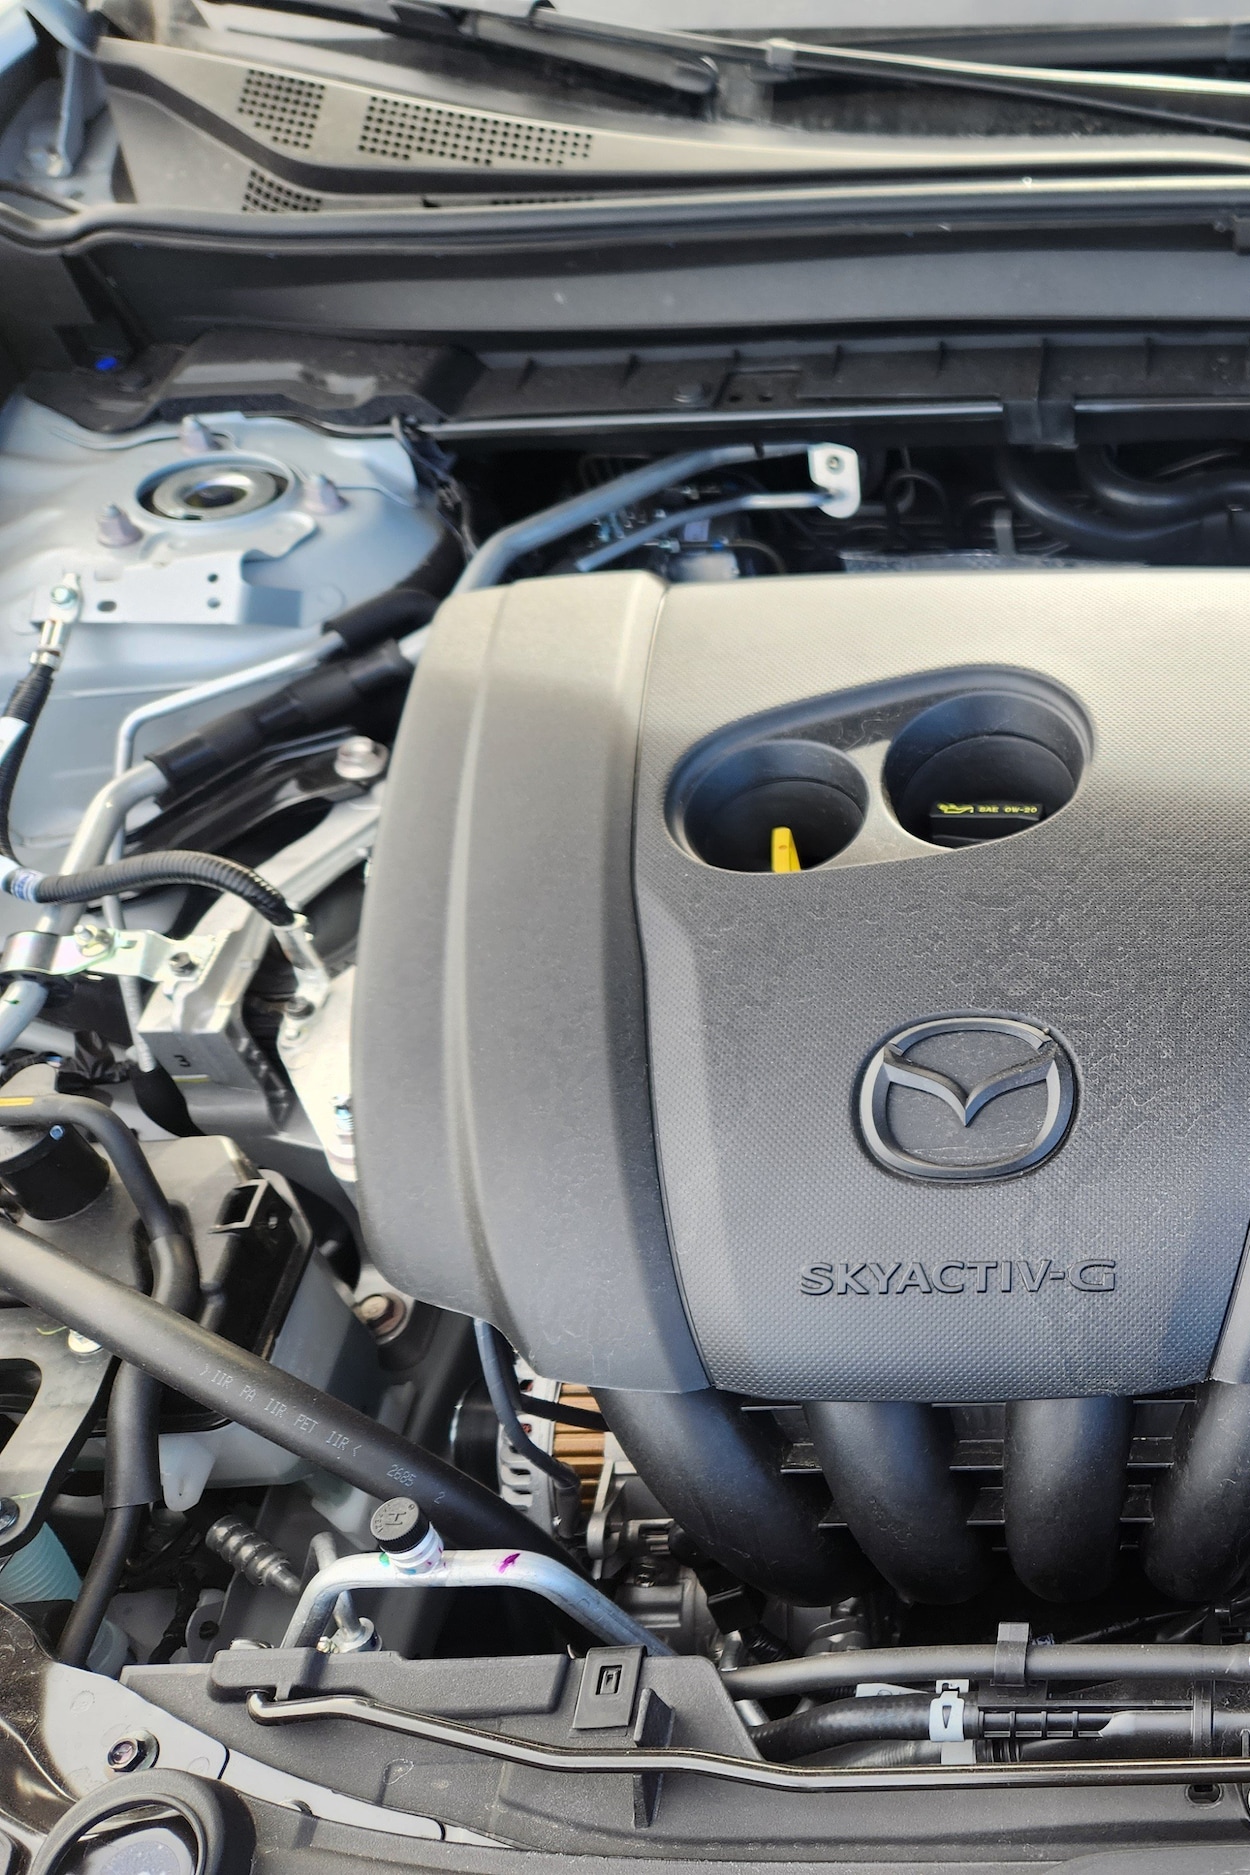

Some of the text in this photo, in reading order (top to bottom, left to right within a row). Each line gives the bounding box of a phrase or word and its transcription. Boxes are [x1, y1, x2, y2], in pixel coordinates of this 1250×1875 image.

[978, 804, 1038, 813] SAE 0W-20
[799, 1258, 1117, 1296] SKYACTIV-G
[293, 1413, 319, 1434] PET
